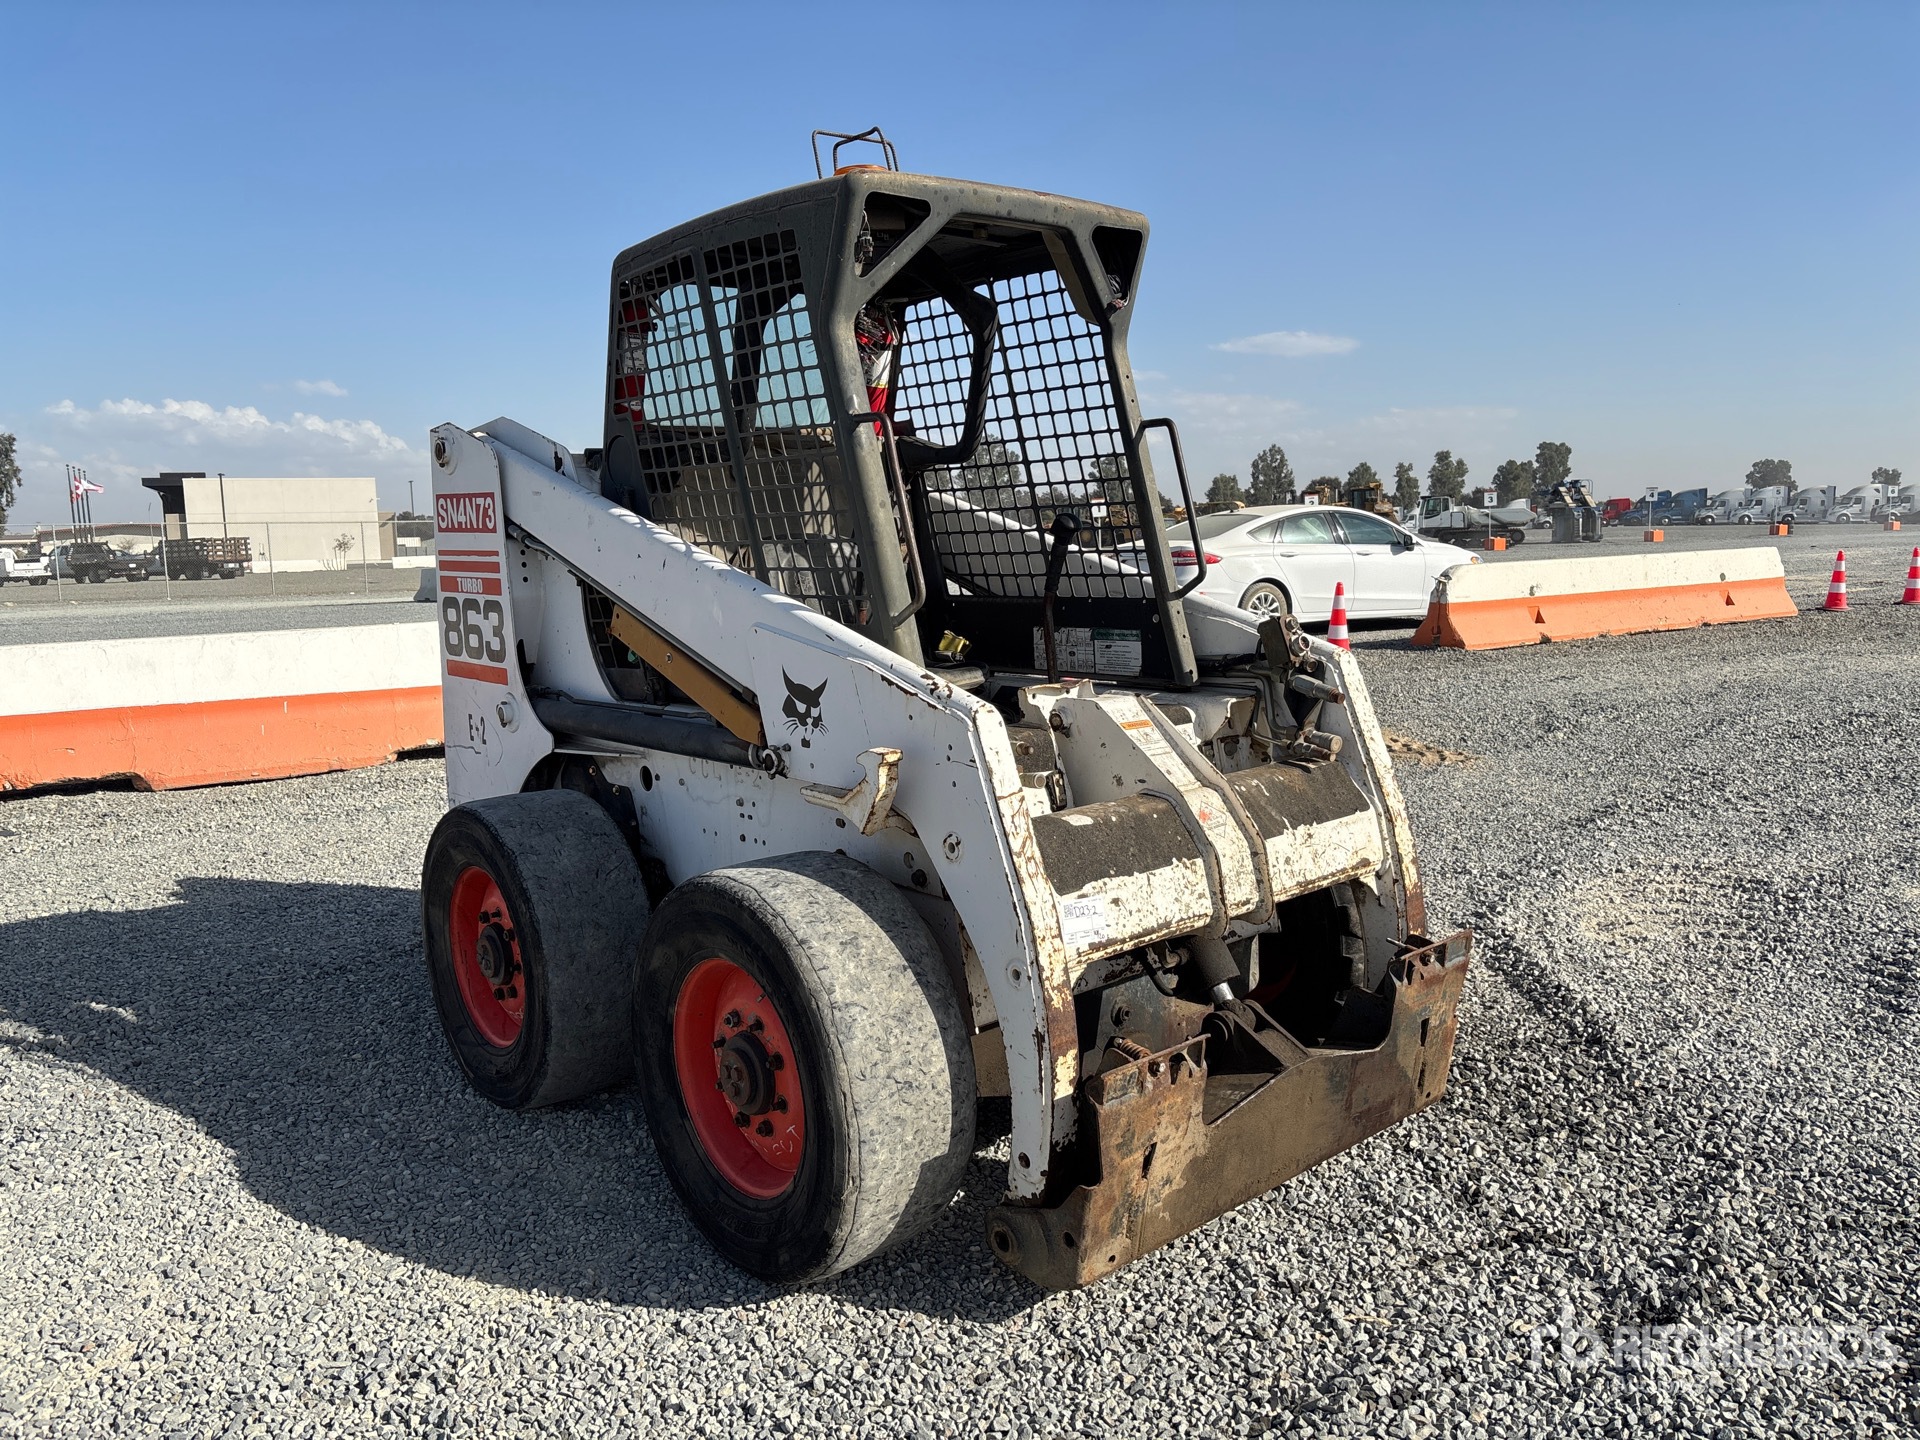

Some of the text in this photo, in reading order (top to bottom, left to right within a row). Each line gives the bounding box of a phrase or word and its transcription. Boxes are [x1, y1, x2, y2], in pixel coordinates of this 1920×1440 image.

[437, 496, 496, 530] SN4N73
[456, 577, 483, 594] TURBO
[442, 596, 507, 664] 863
